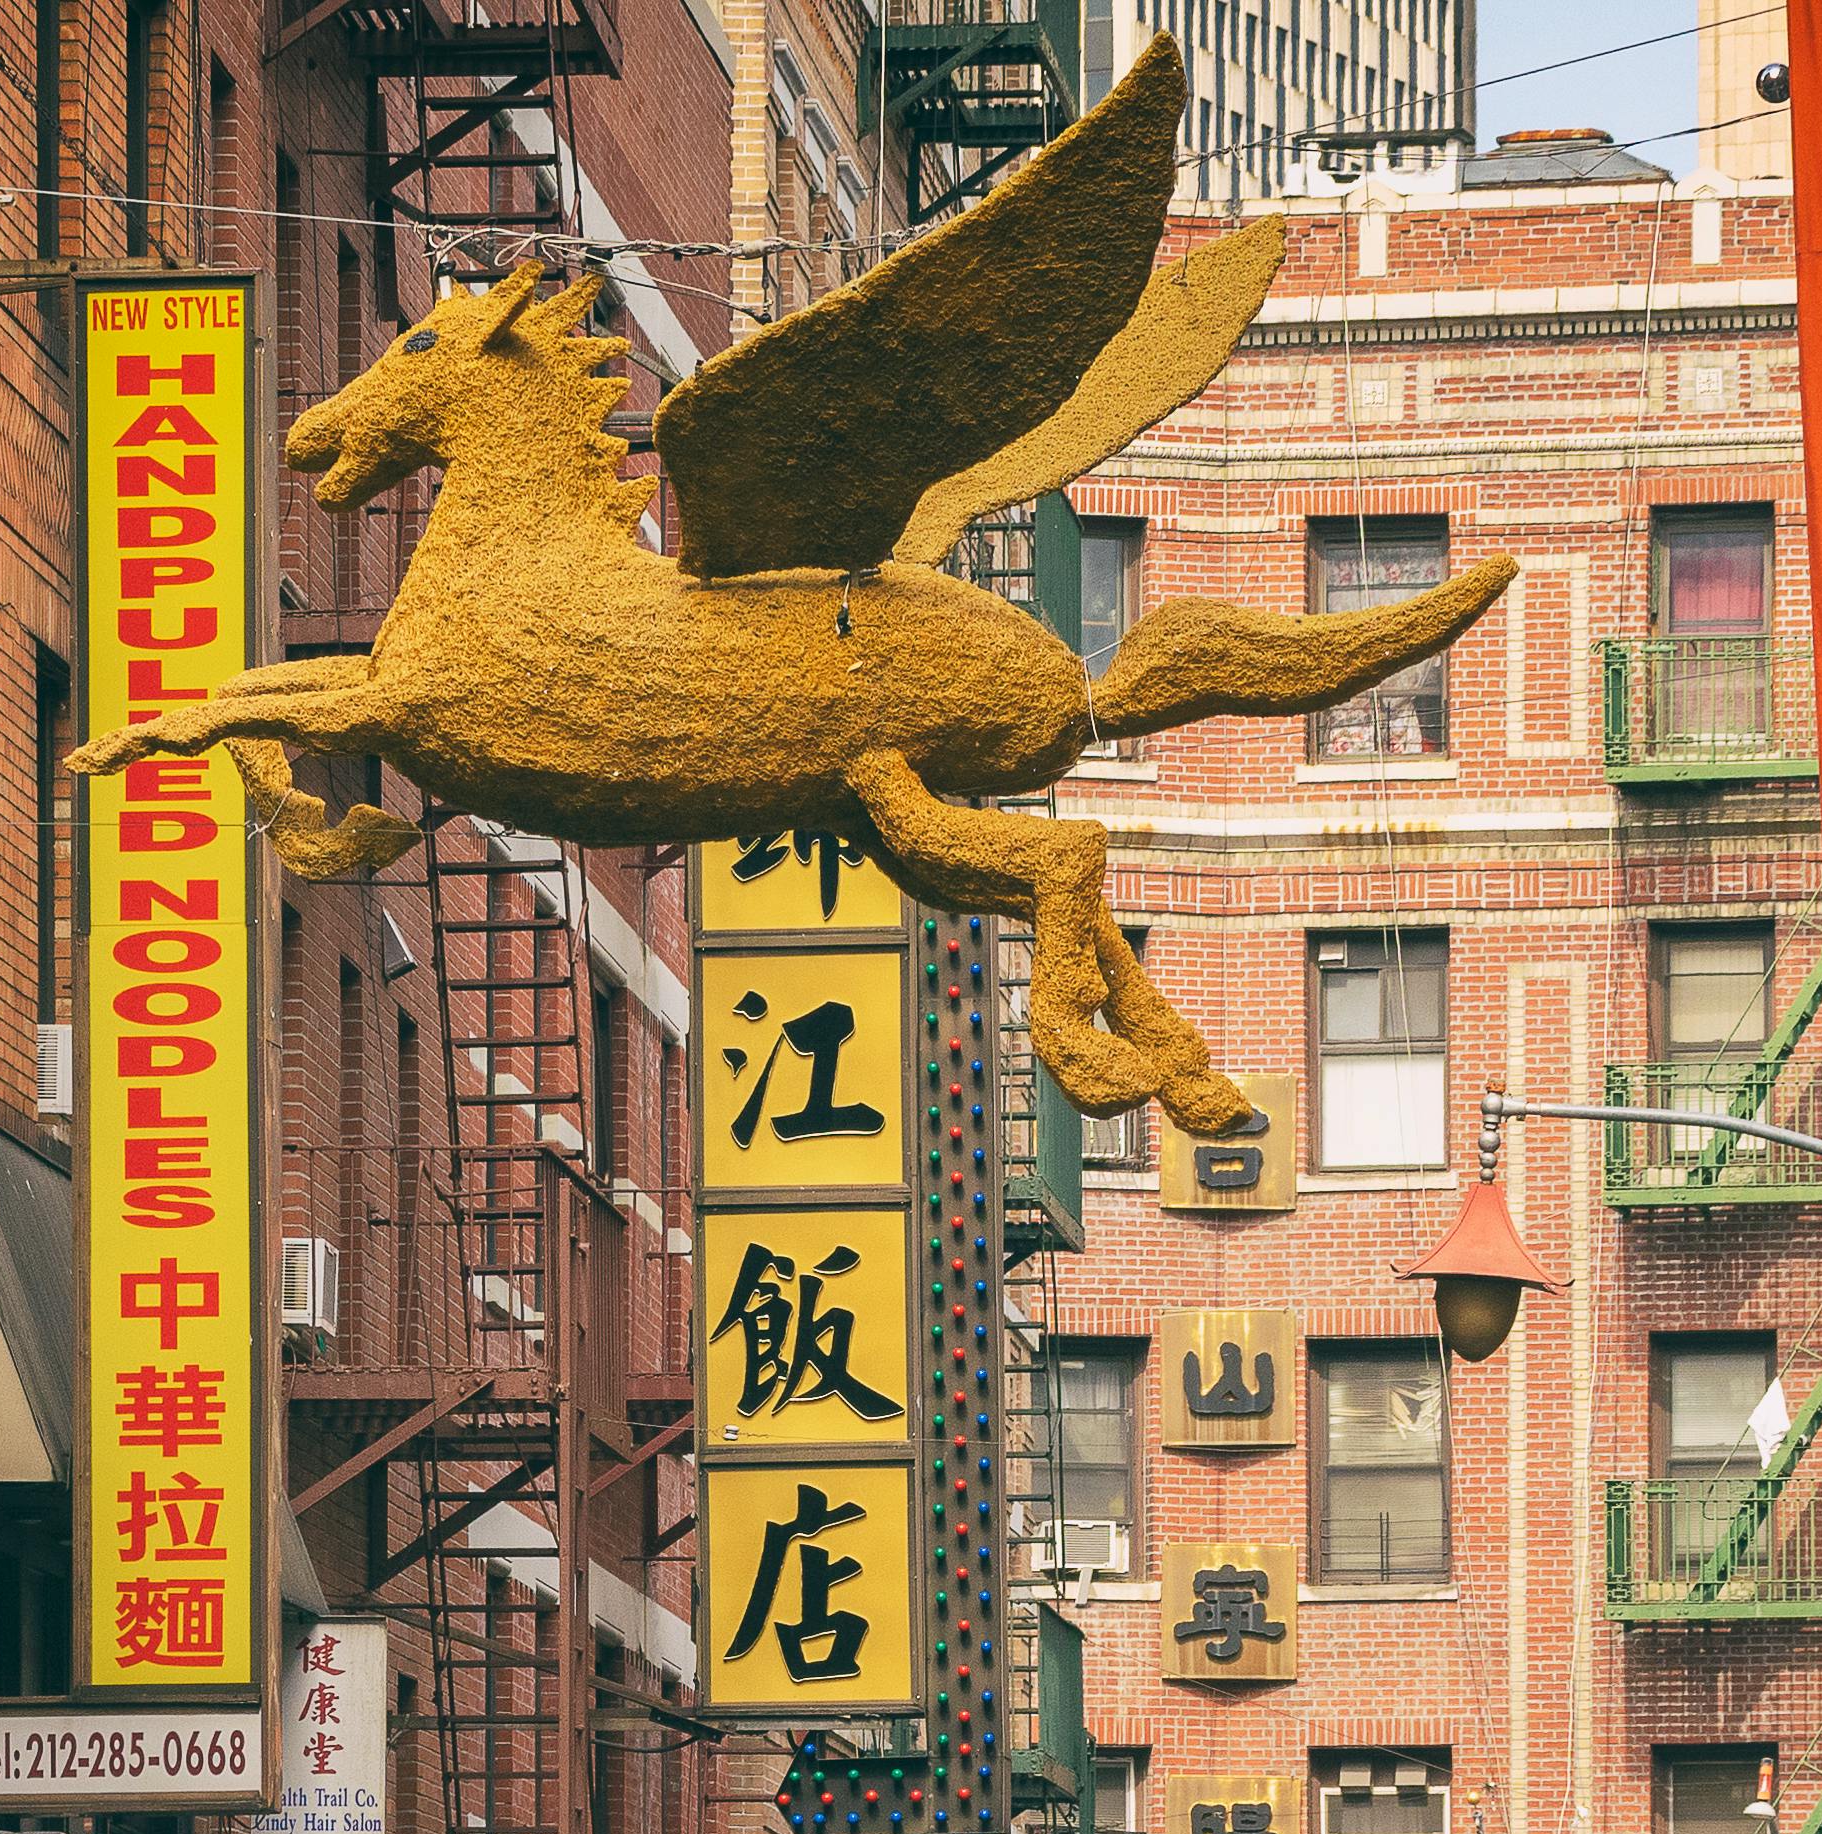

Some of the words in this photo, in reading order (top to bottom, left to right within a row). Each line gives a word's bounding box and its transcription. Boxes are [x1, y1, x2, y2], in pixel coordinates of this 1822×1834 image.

[92, 297, 149, 332] NEW
[163, 295, 240, 330] STYLE
[113, 879, 222, 1229] NOODLES
[115, 1257, 227, 1669] 中華拉麵
[295, 1633, 346, 1775] 健康堂
[281, 1787, 308, 1808] alth
[315, 1787, 348, 1808] Trail
[354, 1788, 379, 1808] Co.
[303, 1813, 337, 1833] Hair
[343, 1812, 382, 1833] Salon
